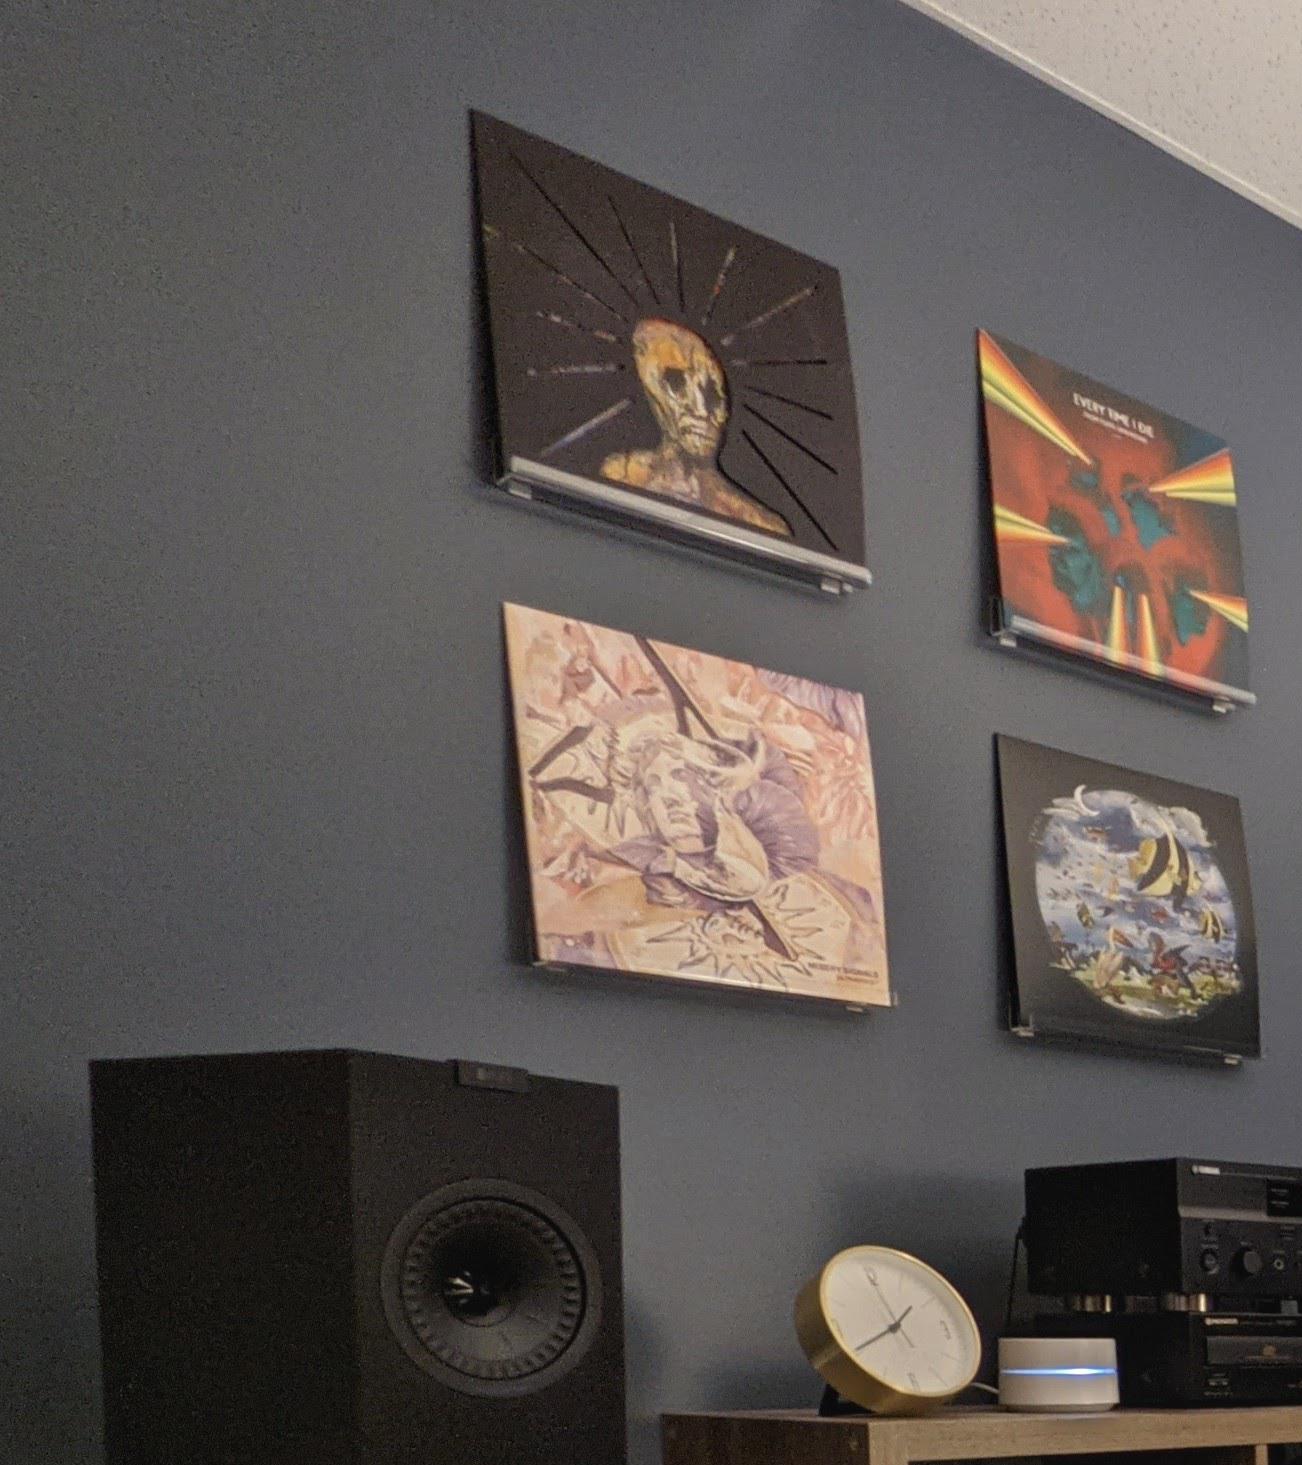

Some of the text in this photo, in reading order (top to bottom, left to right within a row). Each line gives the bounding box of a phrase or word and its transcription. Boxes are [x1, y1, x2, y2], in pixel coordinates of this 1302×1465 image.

[1073, 393, 1106, 416] EVERY
[1107, 407, 1130, 428] TIME
[1137, 421, 1155, 439] DIE
